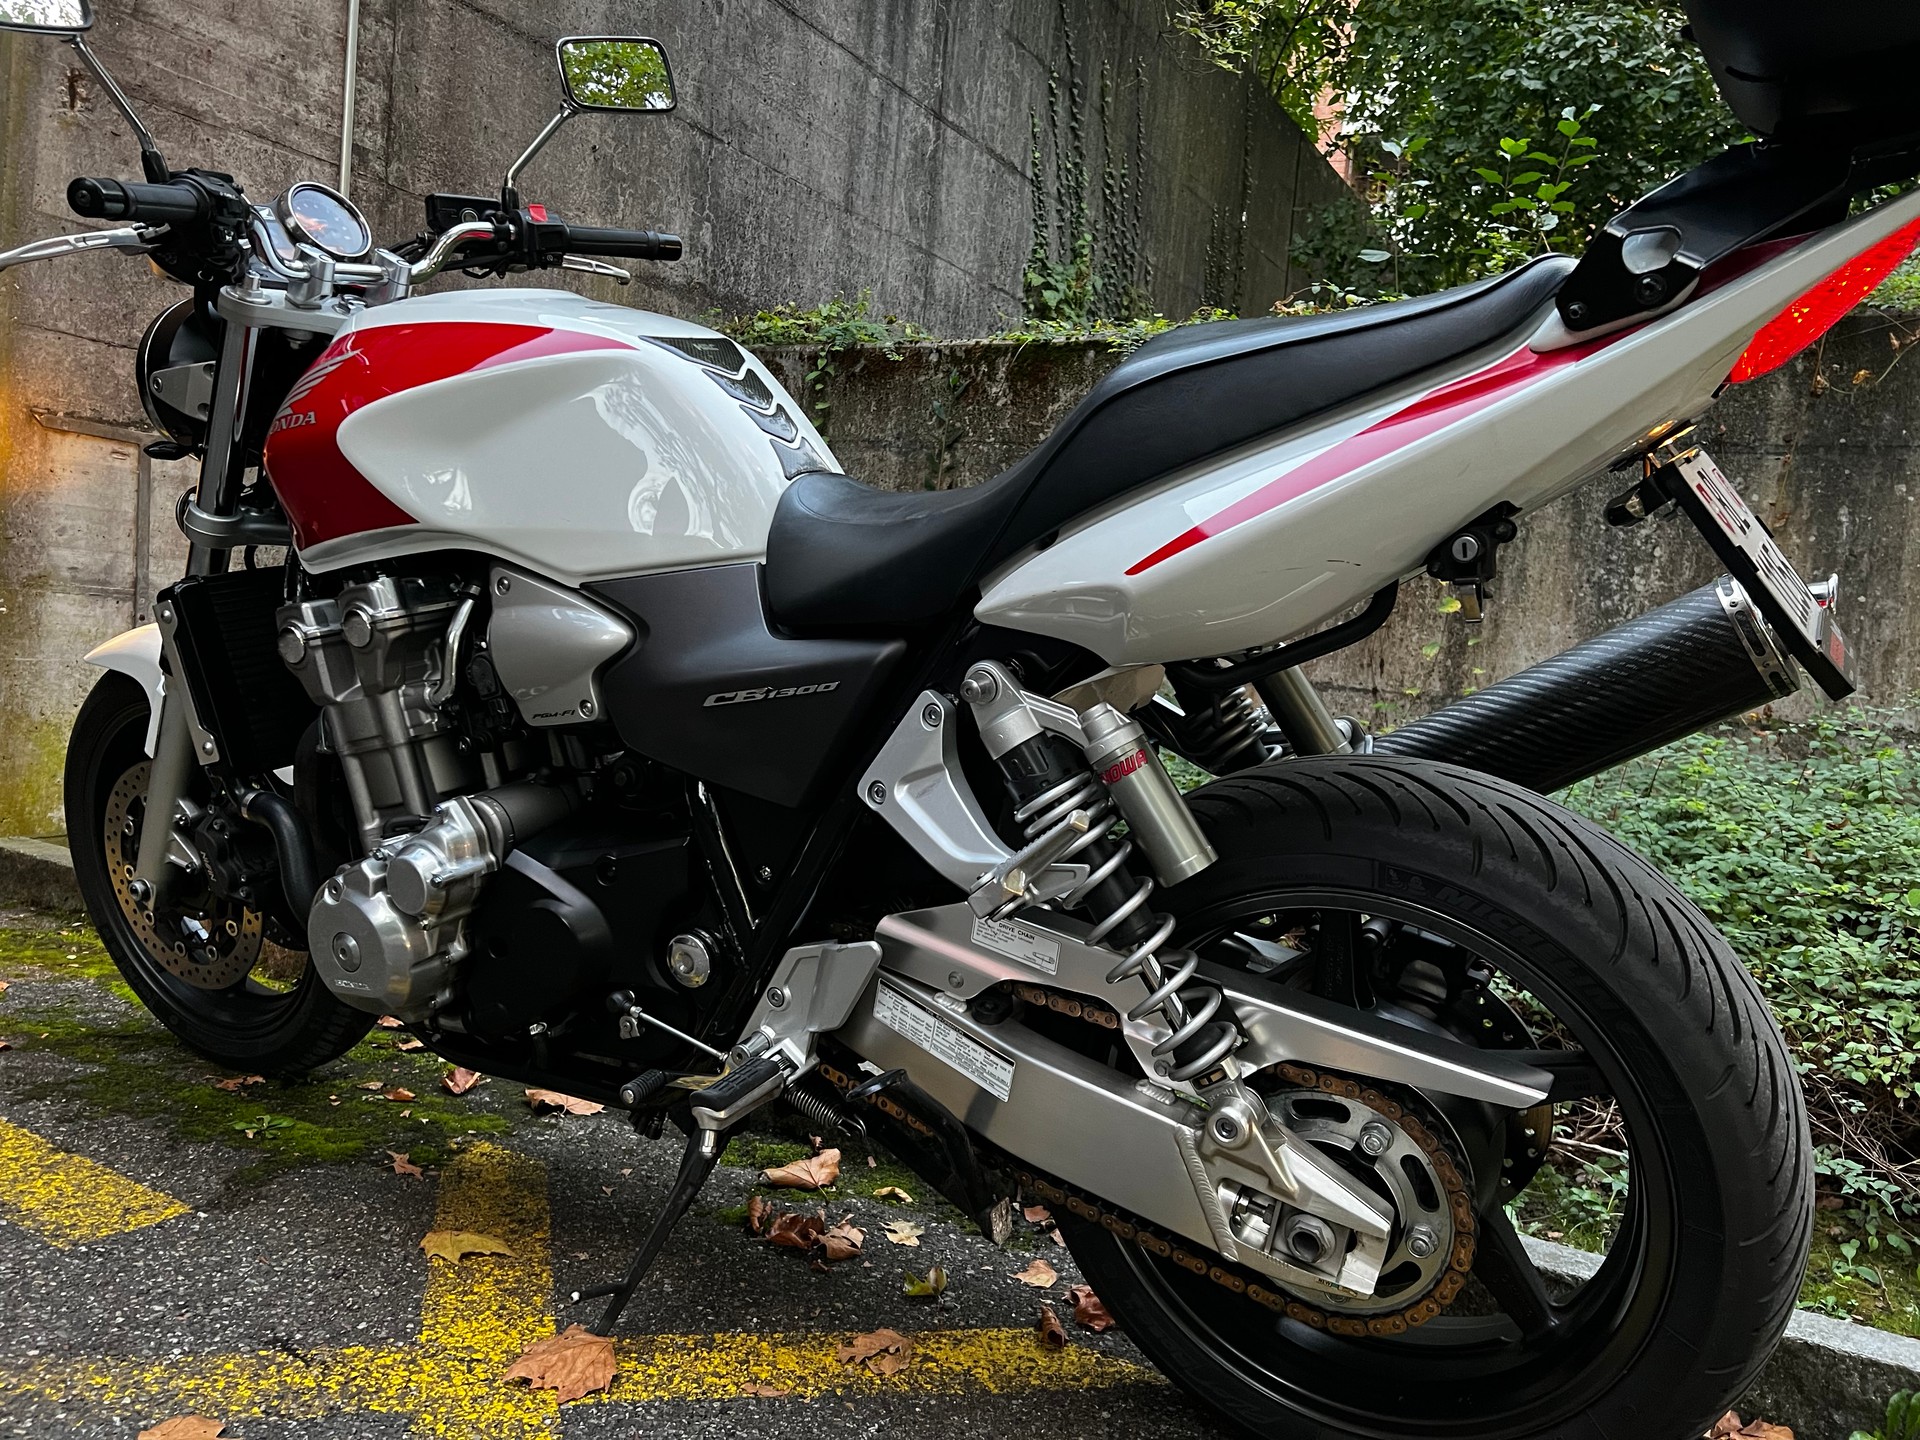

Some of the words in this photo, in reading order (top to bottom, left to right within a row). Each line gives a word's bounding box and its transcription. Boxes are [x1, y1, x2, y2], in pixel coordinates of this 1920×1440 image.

[269, 411, 317, 435] ONDA
[1696, 467, 1751, 536] BL
[1755, 538, 1812, 629] 11156
